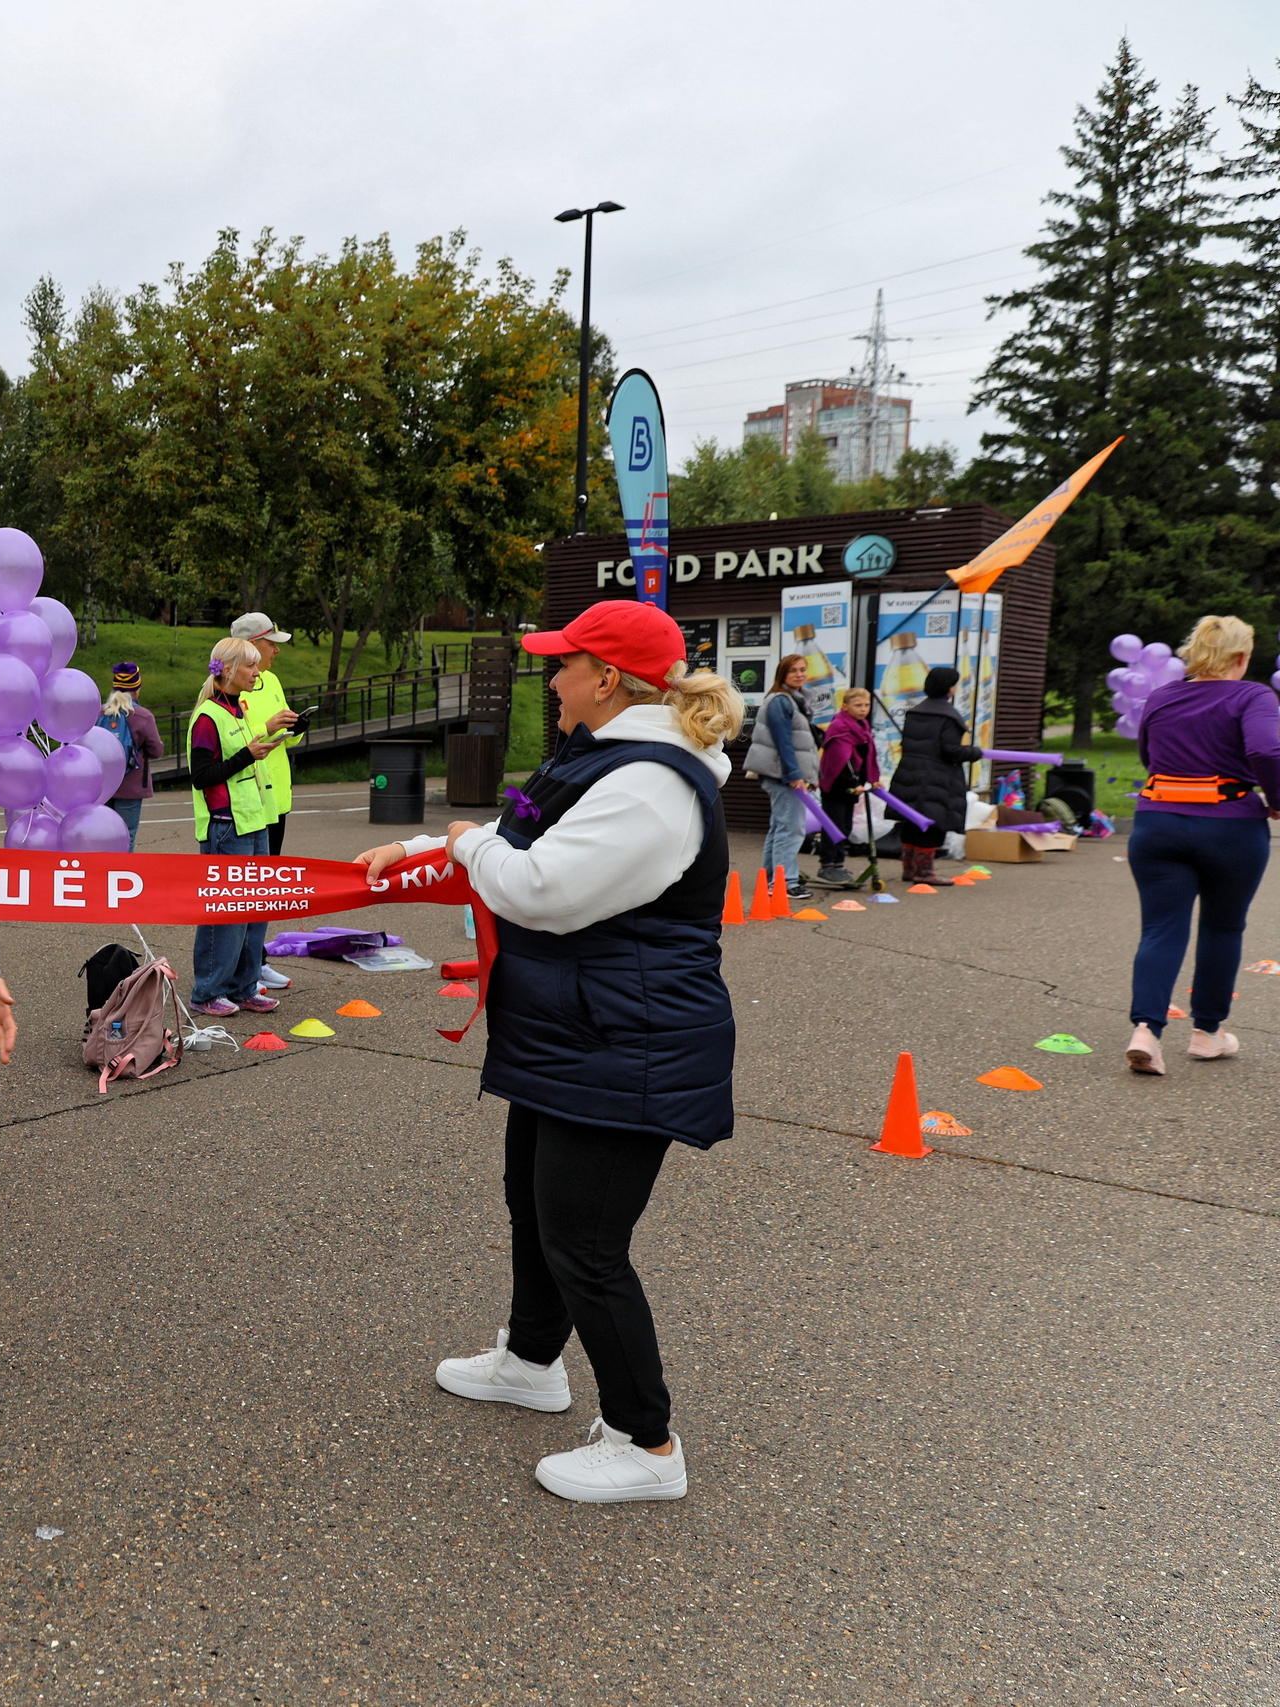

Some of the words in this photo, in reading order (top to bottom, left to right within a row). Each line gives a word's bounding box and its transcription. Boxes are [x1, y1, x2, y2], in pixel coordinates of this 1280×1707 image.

[596, 554, 701, 588] FOD
[714, 544, 824, 580] PARK
[206, 865, 221, 883] 5
[227, 861, 307, 883] ВЁРСТ
[197, 886, 316, 898] КРАСНОЯРСК
[205, 899, 309, 913] НАБЕРЕЖНАЯ
